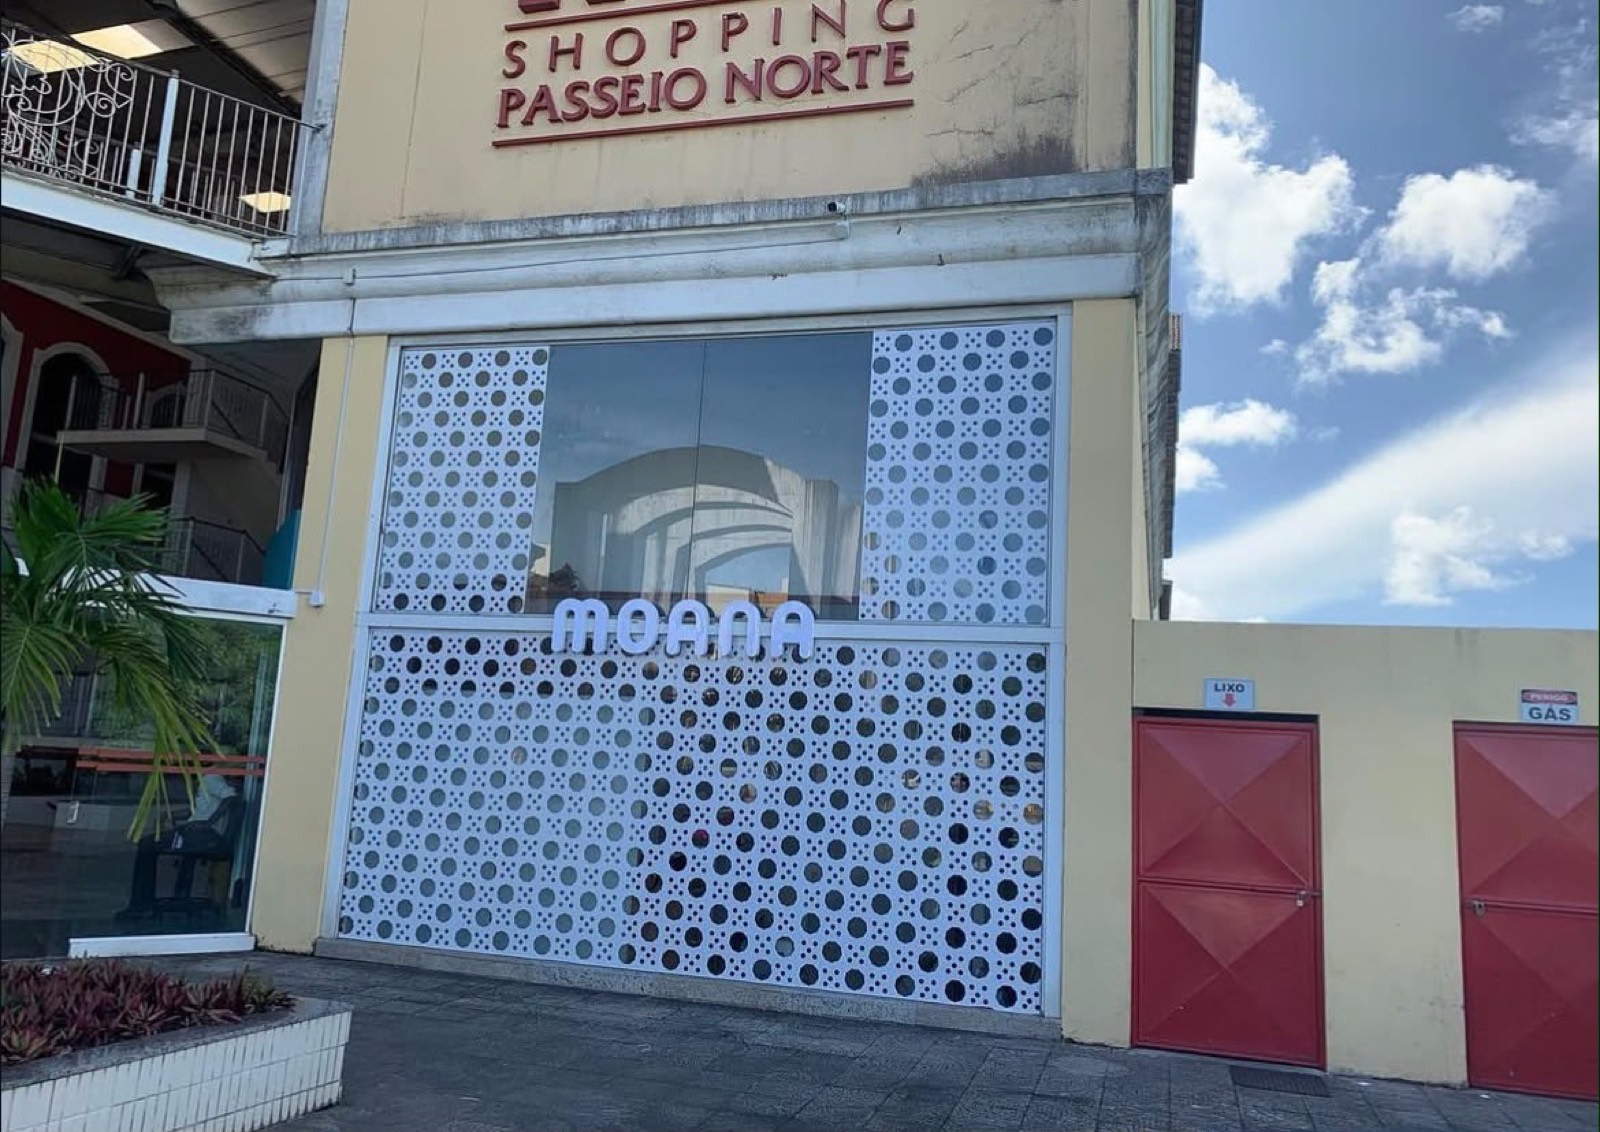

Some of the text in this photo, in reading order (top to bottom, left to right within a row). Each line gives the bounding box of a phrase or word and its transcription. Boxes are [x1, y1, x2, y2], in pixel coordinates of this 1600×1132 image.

[503, 0, 914, 78] SHOPPING
[497, 41, 914, 128] PASSEIO NORTE
[551, 598, 816, 659] MOANA
[1213, 682, 1245, 693] LIXO
[1528, 704, 1571, 721] GÁS
